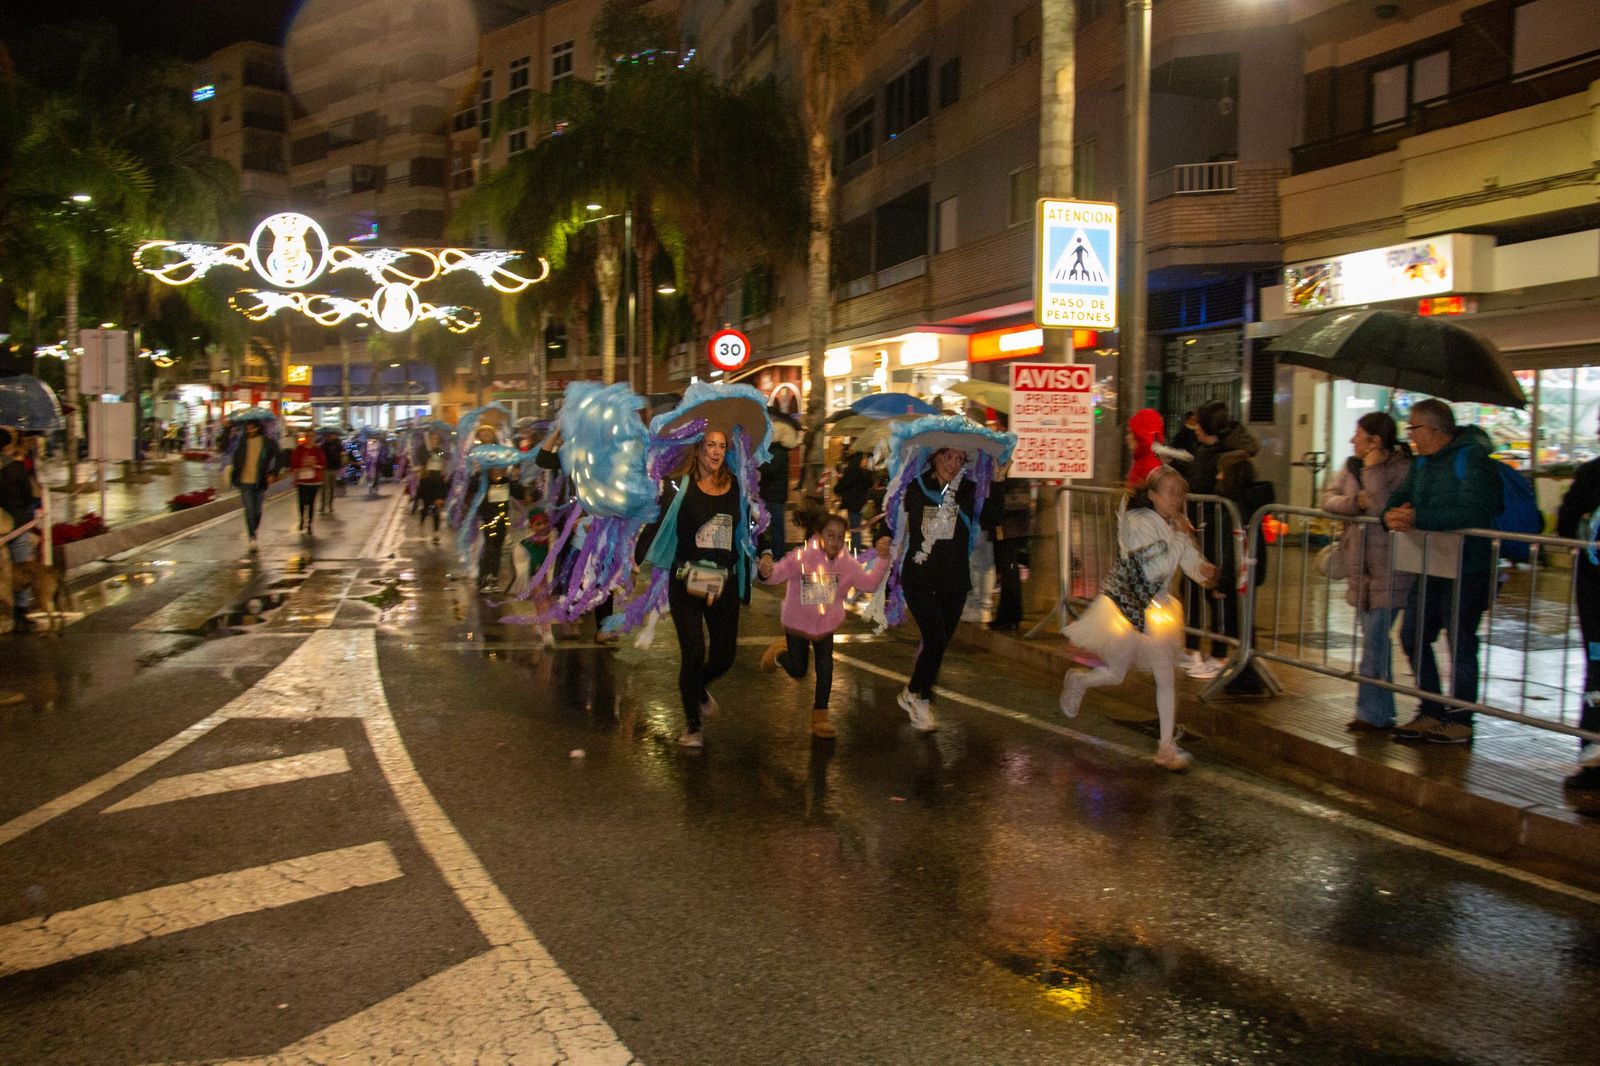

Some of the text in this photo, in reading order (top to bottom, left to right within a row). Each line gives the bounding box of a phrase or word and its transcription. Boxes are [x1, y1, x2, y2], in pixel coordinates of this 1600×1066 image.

[1052, 298, 1106, 310] PASO DE
[1047, 310, 1111, 322] PEATONES
[720, 343, 741, 356] 30
[1015, 368, 1089, 390] AVISO
[1025, 393, 1079, 404] PRUEBA
[1015, 404, 1089, 415] DEPORTIVA
[1014, 449, 1089, 460] CORTADO
